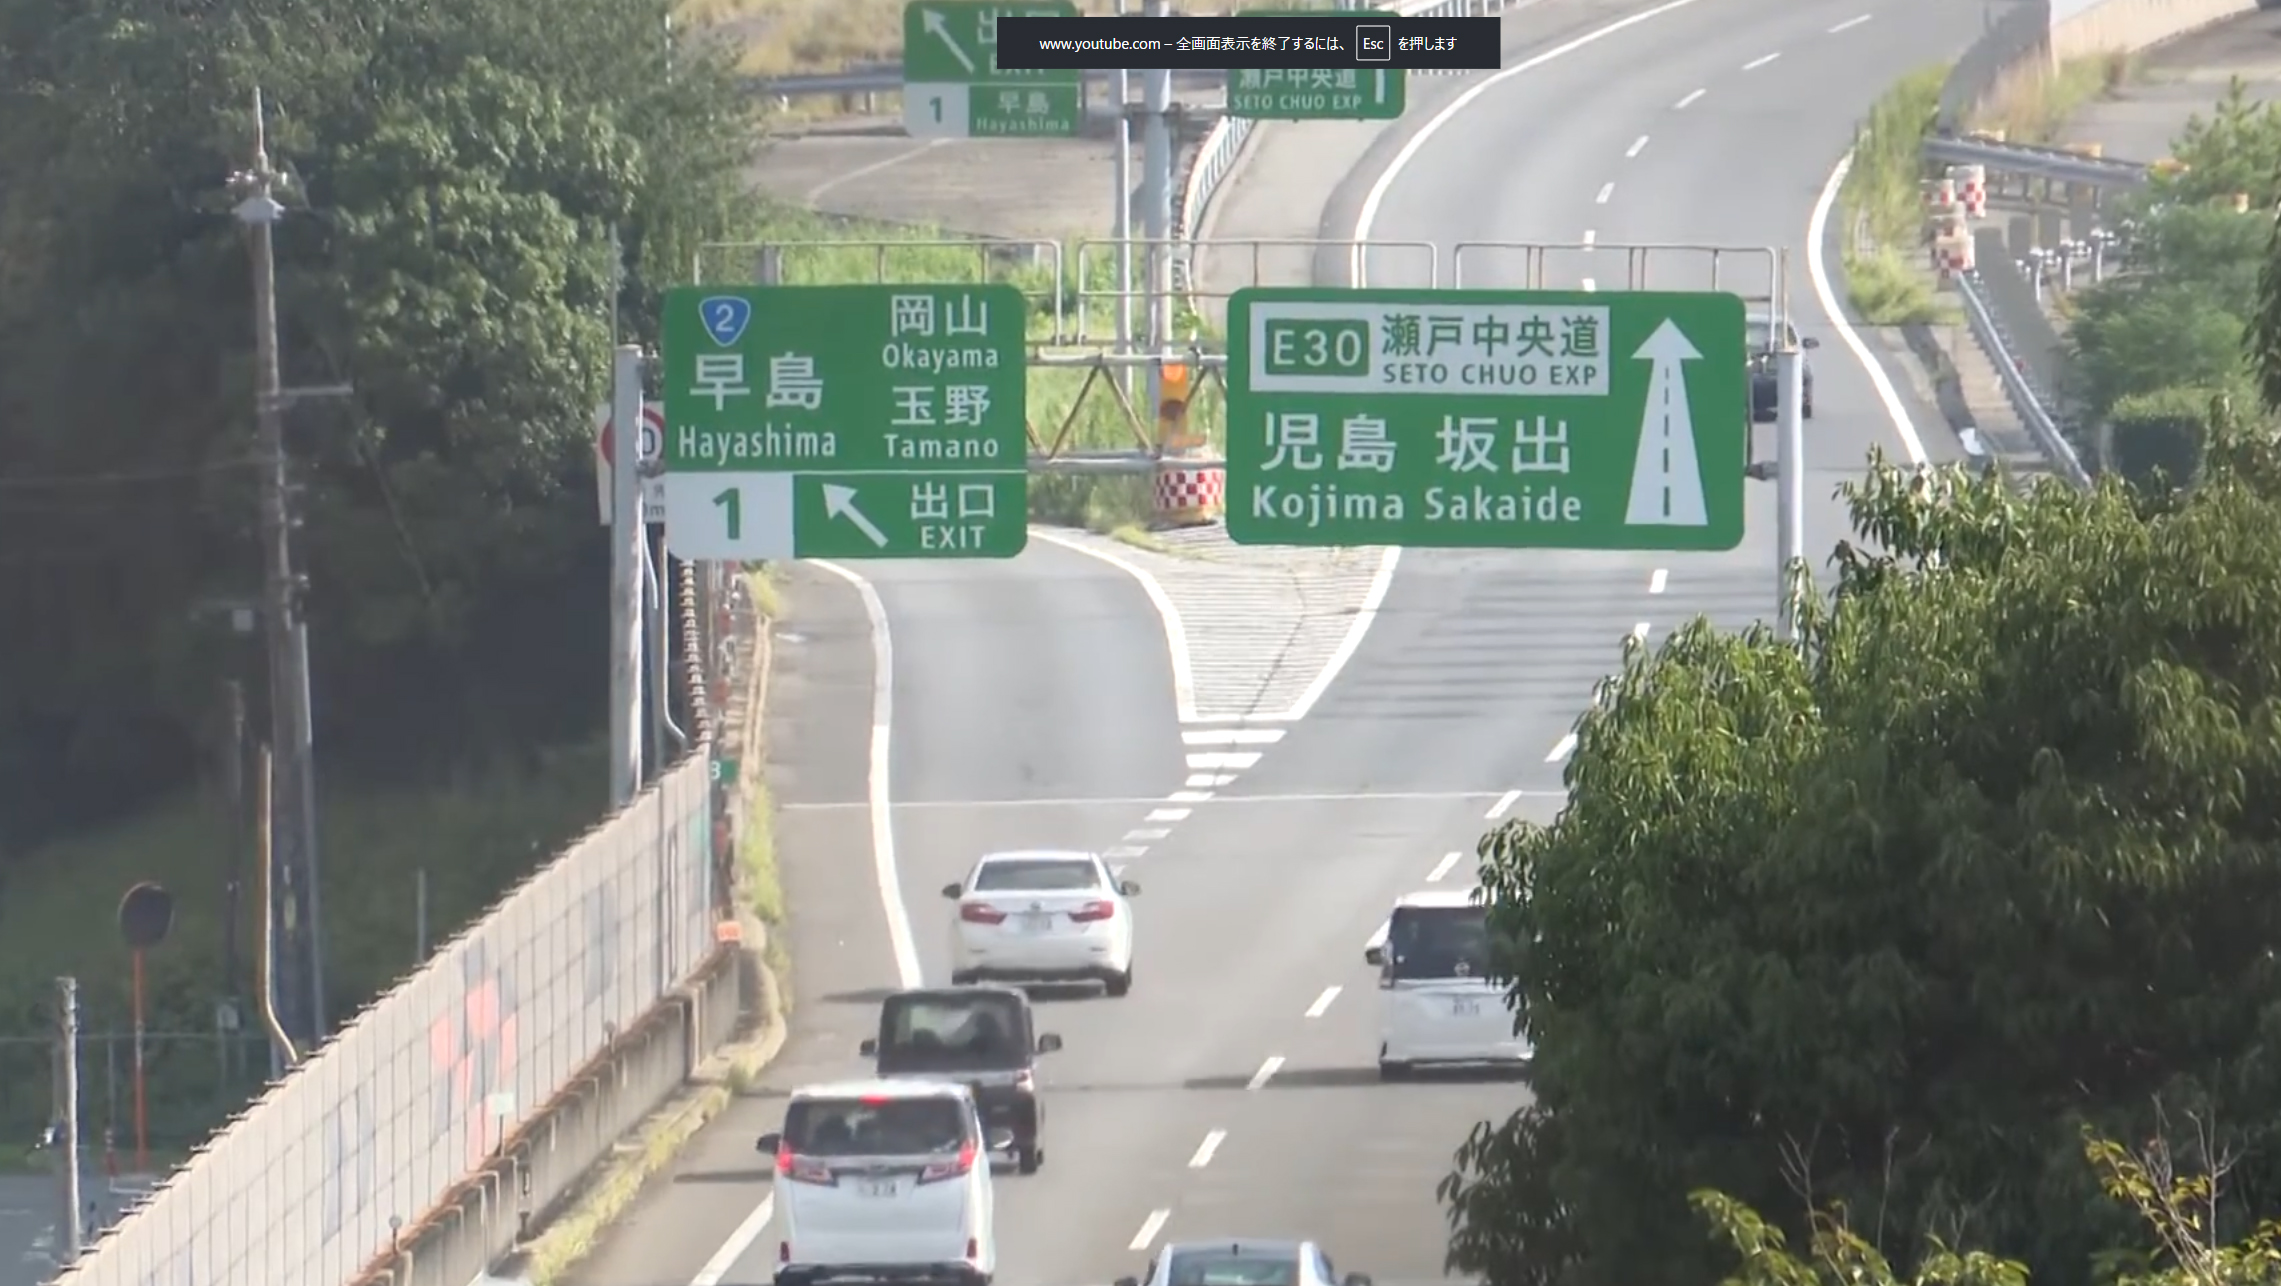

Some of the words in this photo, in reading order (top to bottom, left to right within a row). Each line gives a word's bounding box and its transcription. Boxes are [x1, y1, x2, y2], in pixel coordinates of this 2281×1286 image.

[930, 97, 943, 124] 1
[999, 91, 1049, 115] 早島
[1233, 94, 1273, 110] SETO
[1280, 95, 1325, 110] CHUO
[1333, 95, 1362, 110] EXP
[976, 117, 1070, 133] Hayashima
[715, 303, 734, 332] 2
[891, 294, 988, 337] 岡山
[1273, 329, 1362, 366] E30
[1381, 313, 1600, 358] 瀬戸中央道
[882, 343, 998, 374] Okayama
[1382, 363, 1449, 384] SETO
[1461, 363, 1537, 385] CHUO
[1550, 364, 1597, 385] EXP
[690, 351, 823, 411] 早島
[891, 384, 990, 427] 玉野
[678, 423, 836, 466] Hayashima
[884, 434, 998, 458] Tamano
[1260, 411, 1398, 473] 児島
[1436, 415, 1571, 474] 坂出
[713, 487, 741, 540] 1
[910, 481, 994, 519] 出口
[1253, 486, 1403, 527] Kojima
[1425, 486, 1581, 522] Sakaide
[921, 525, 986, 549] EXIT
